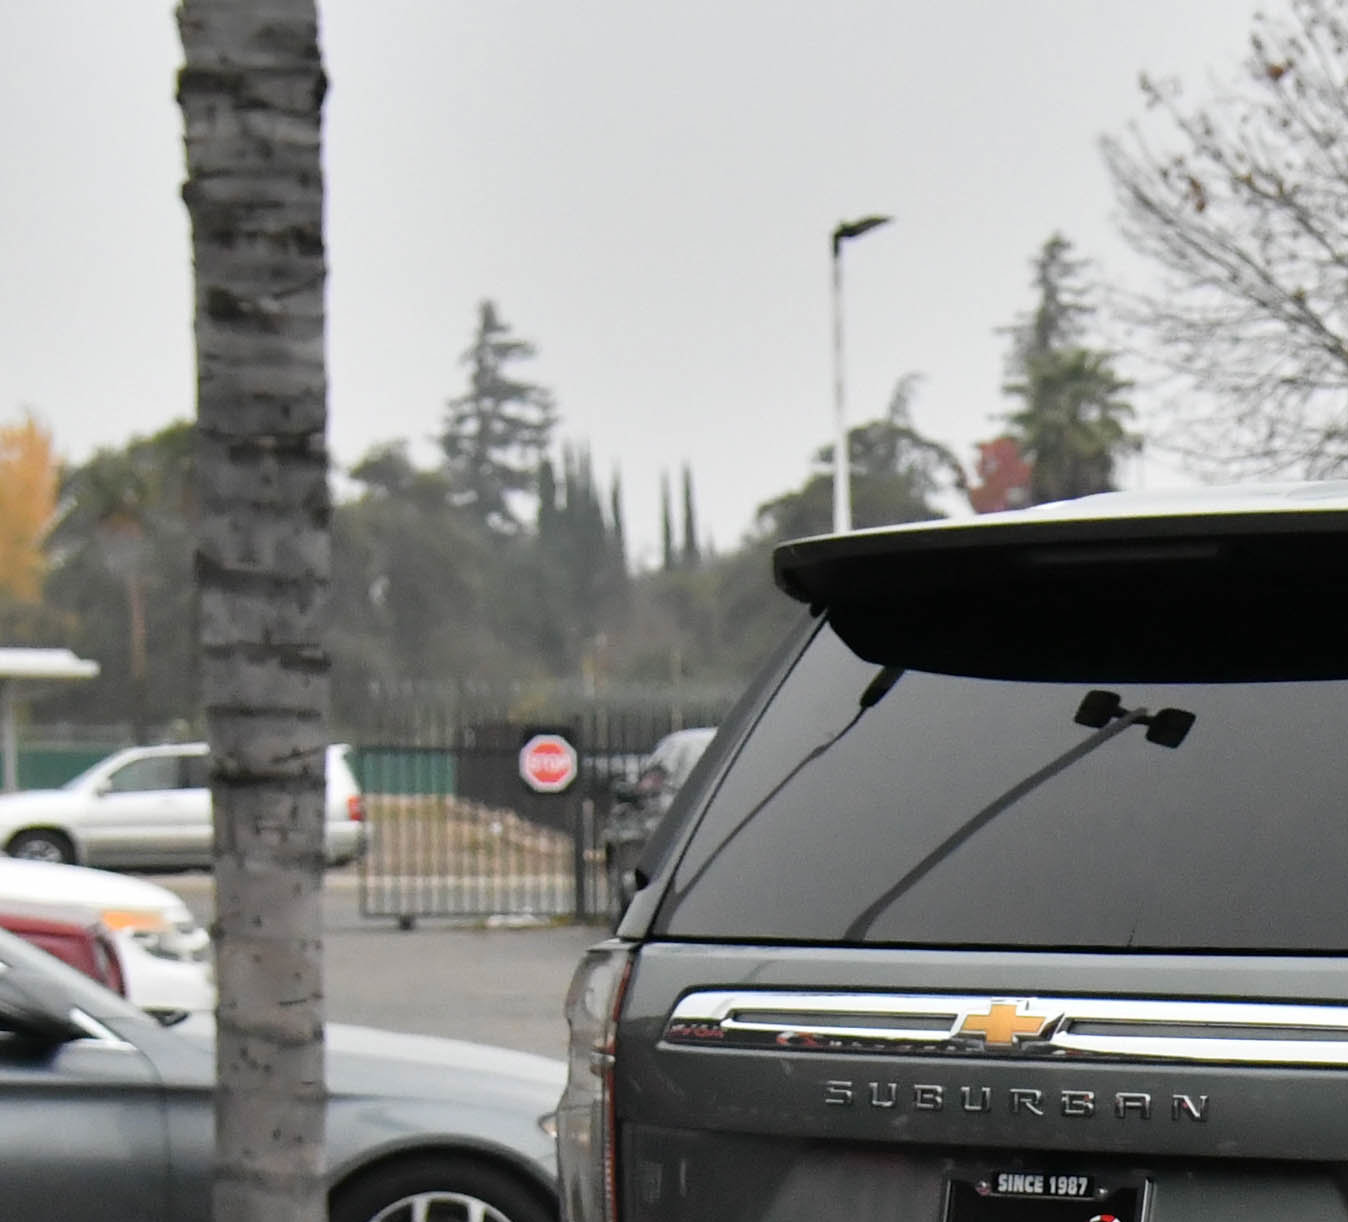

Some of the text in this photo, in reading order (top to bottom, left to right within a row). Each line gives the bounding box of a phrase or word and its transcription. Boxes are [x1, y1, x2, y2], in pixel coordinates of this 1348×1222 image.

[528, 751, 571, 774] STOP
[824, 1079, 1209, 1122] SUBURBAN
[997, 1173, 1088, 1196] SINCE 1987
